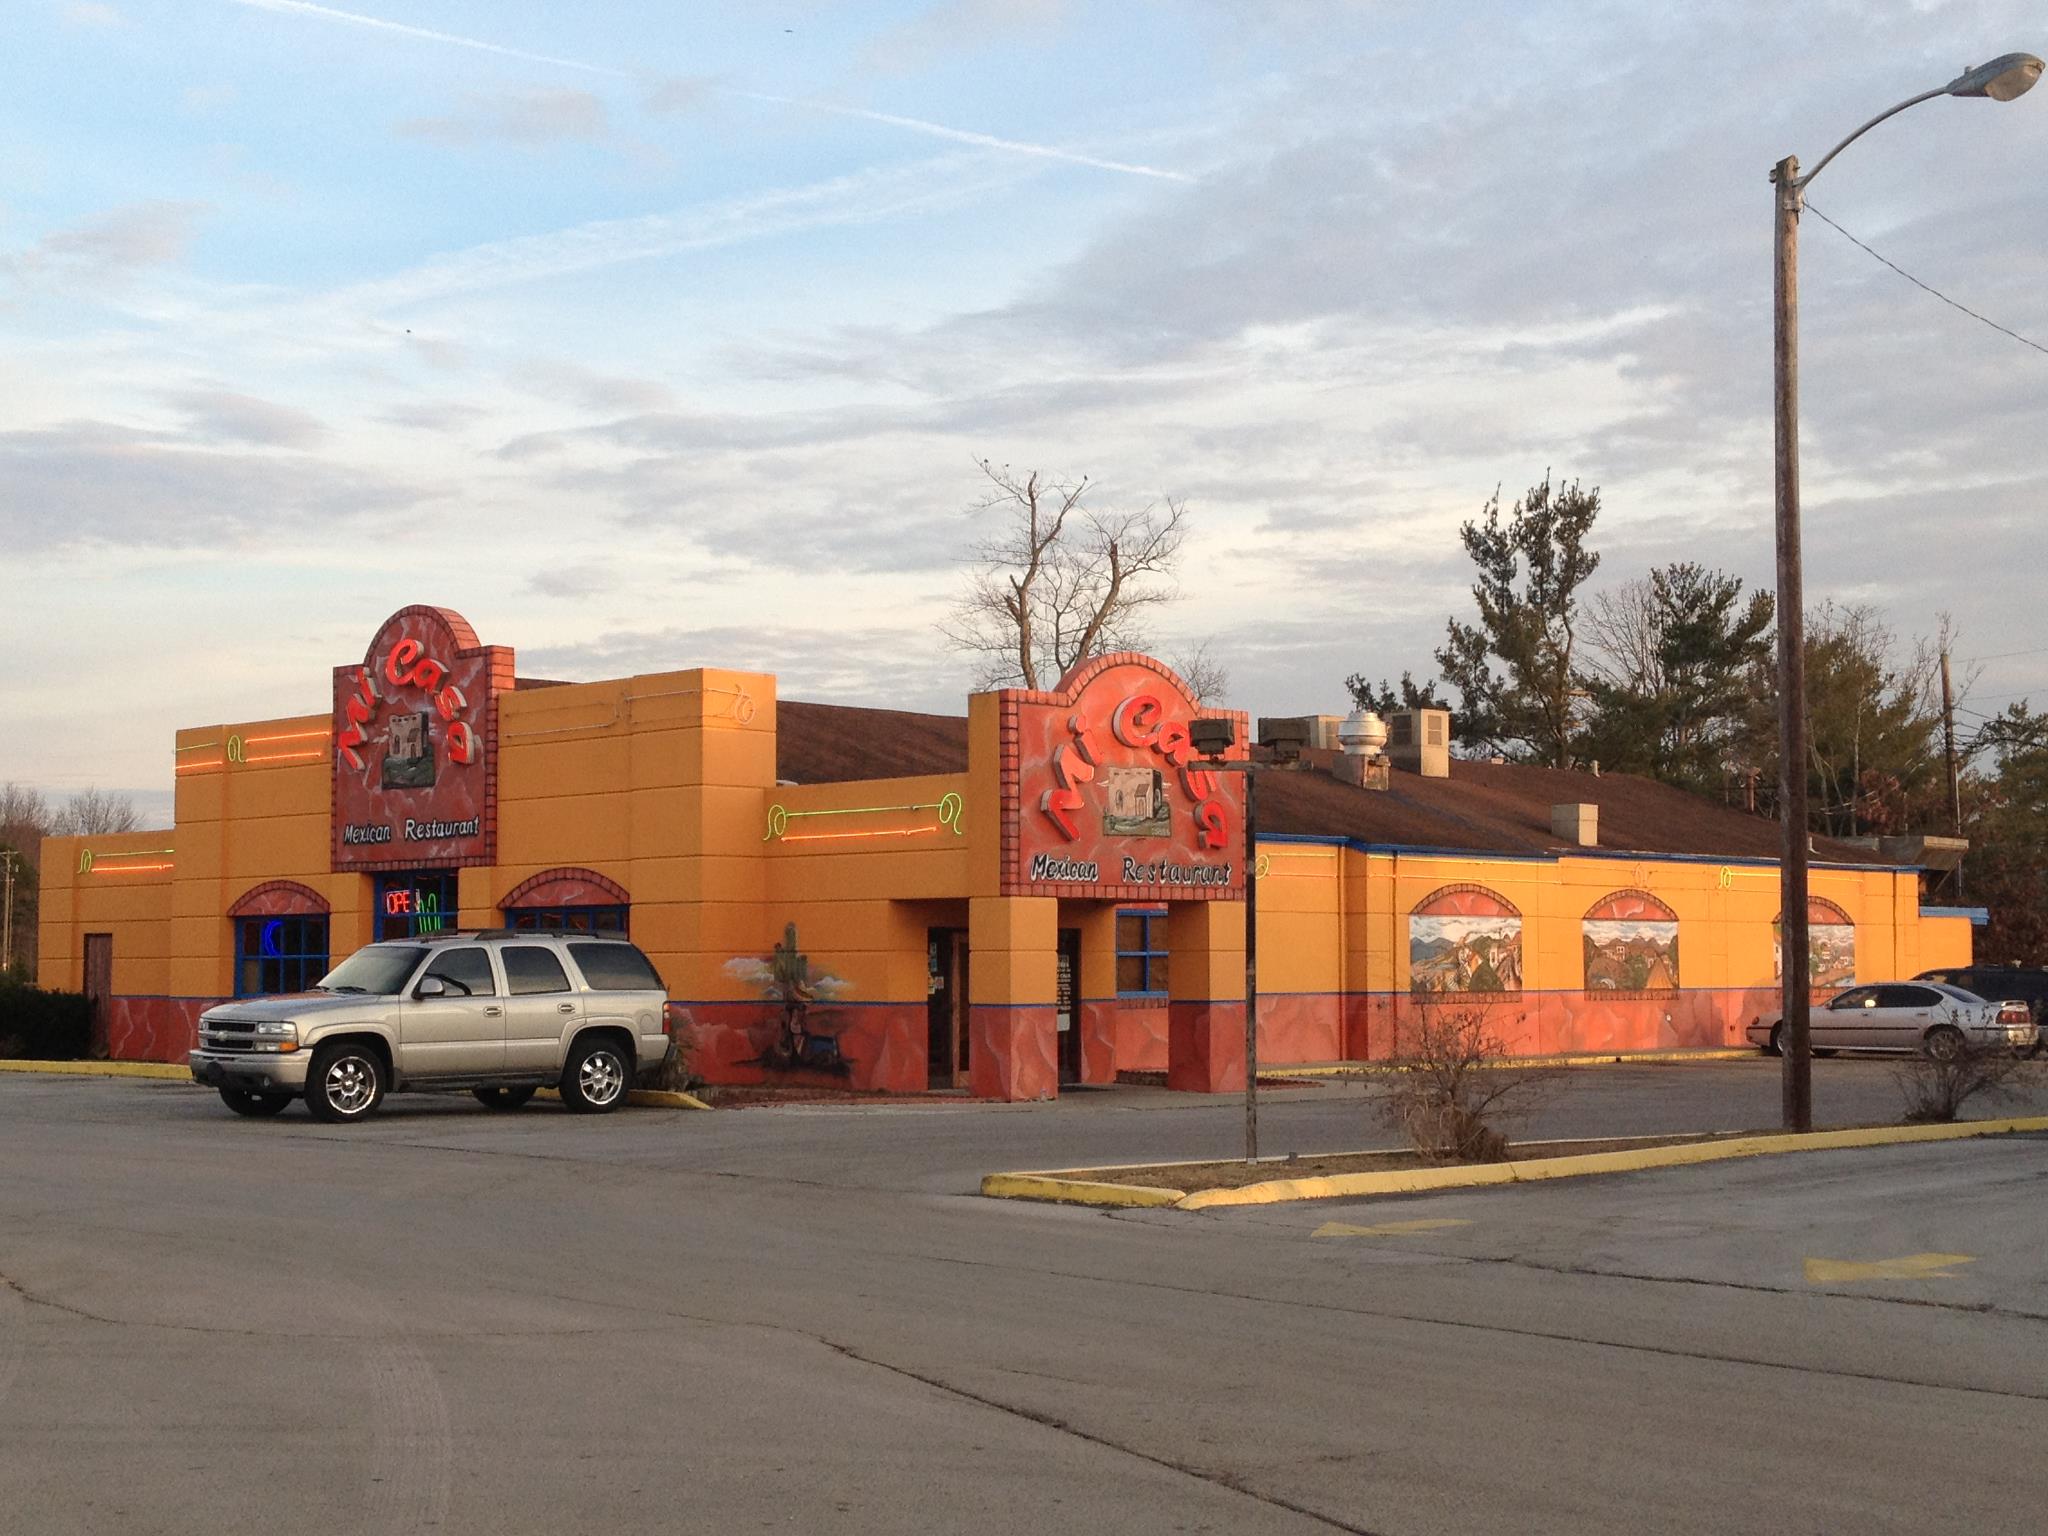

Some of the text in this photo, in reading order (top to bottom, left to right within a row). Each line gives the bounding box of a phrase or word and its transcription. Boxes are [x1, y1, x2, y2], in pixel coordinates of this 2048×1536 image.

[338, 638, 474, 770] Mi Casa
[1040, 695, 1229, 849] Mi Casa
[344, 815, 479, 844] Mexican Restaurant
[1030, 853, 1232, 886] Mexican Restaurant
[388, 891, 411, 915] OPE
